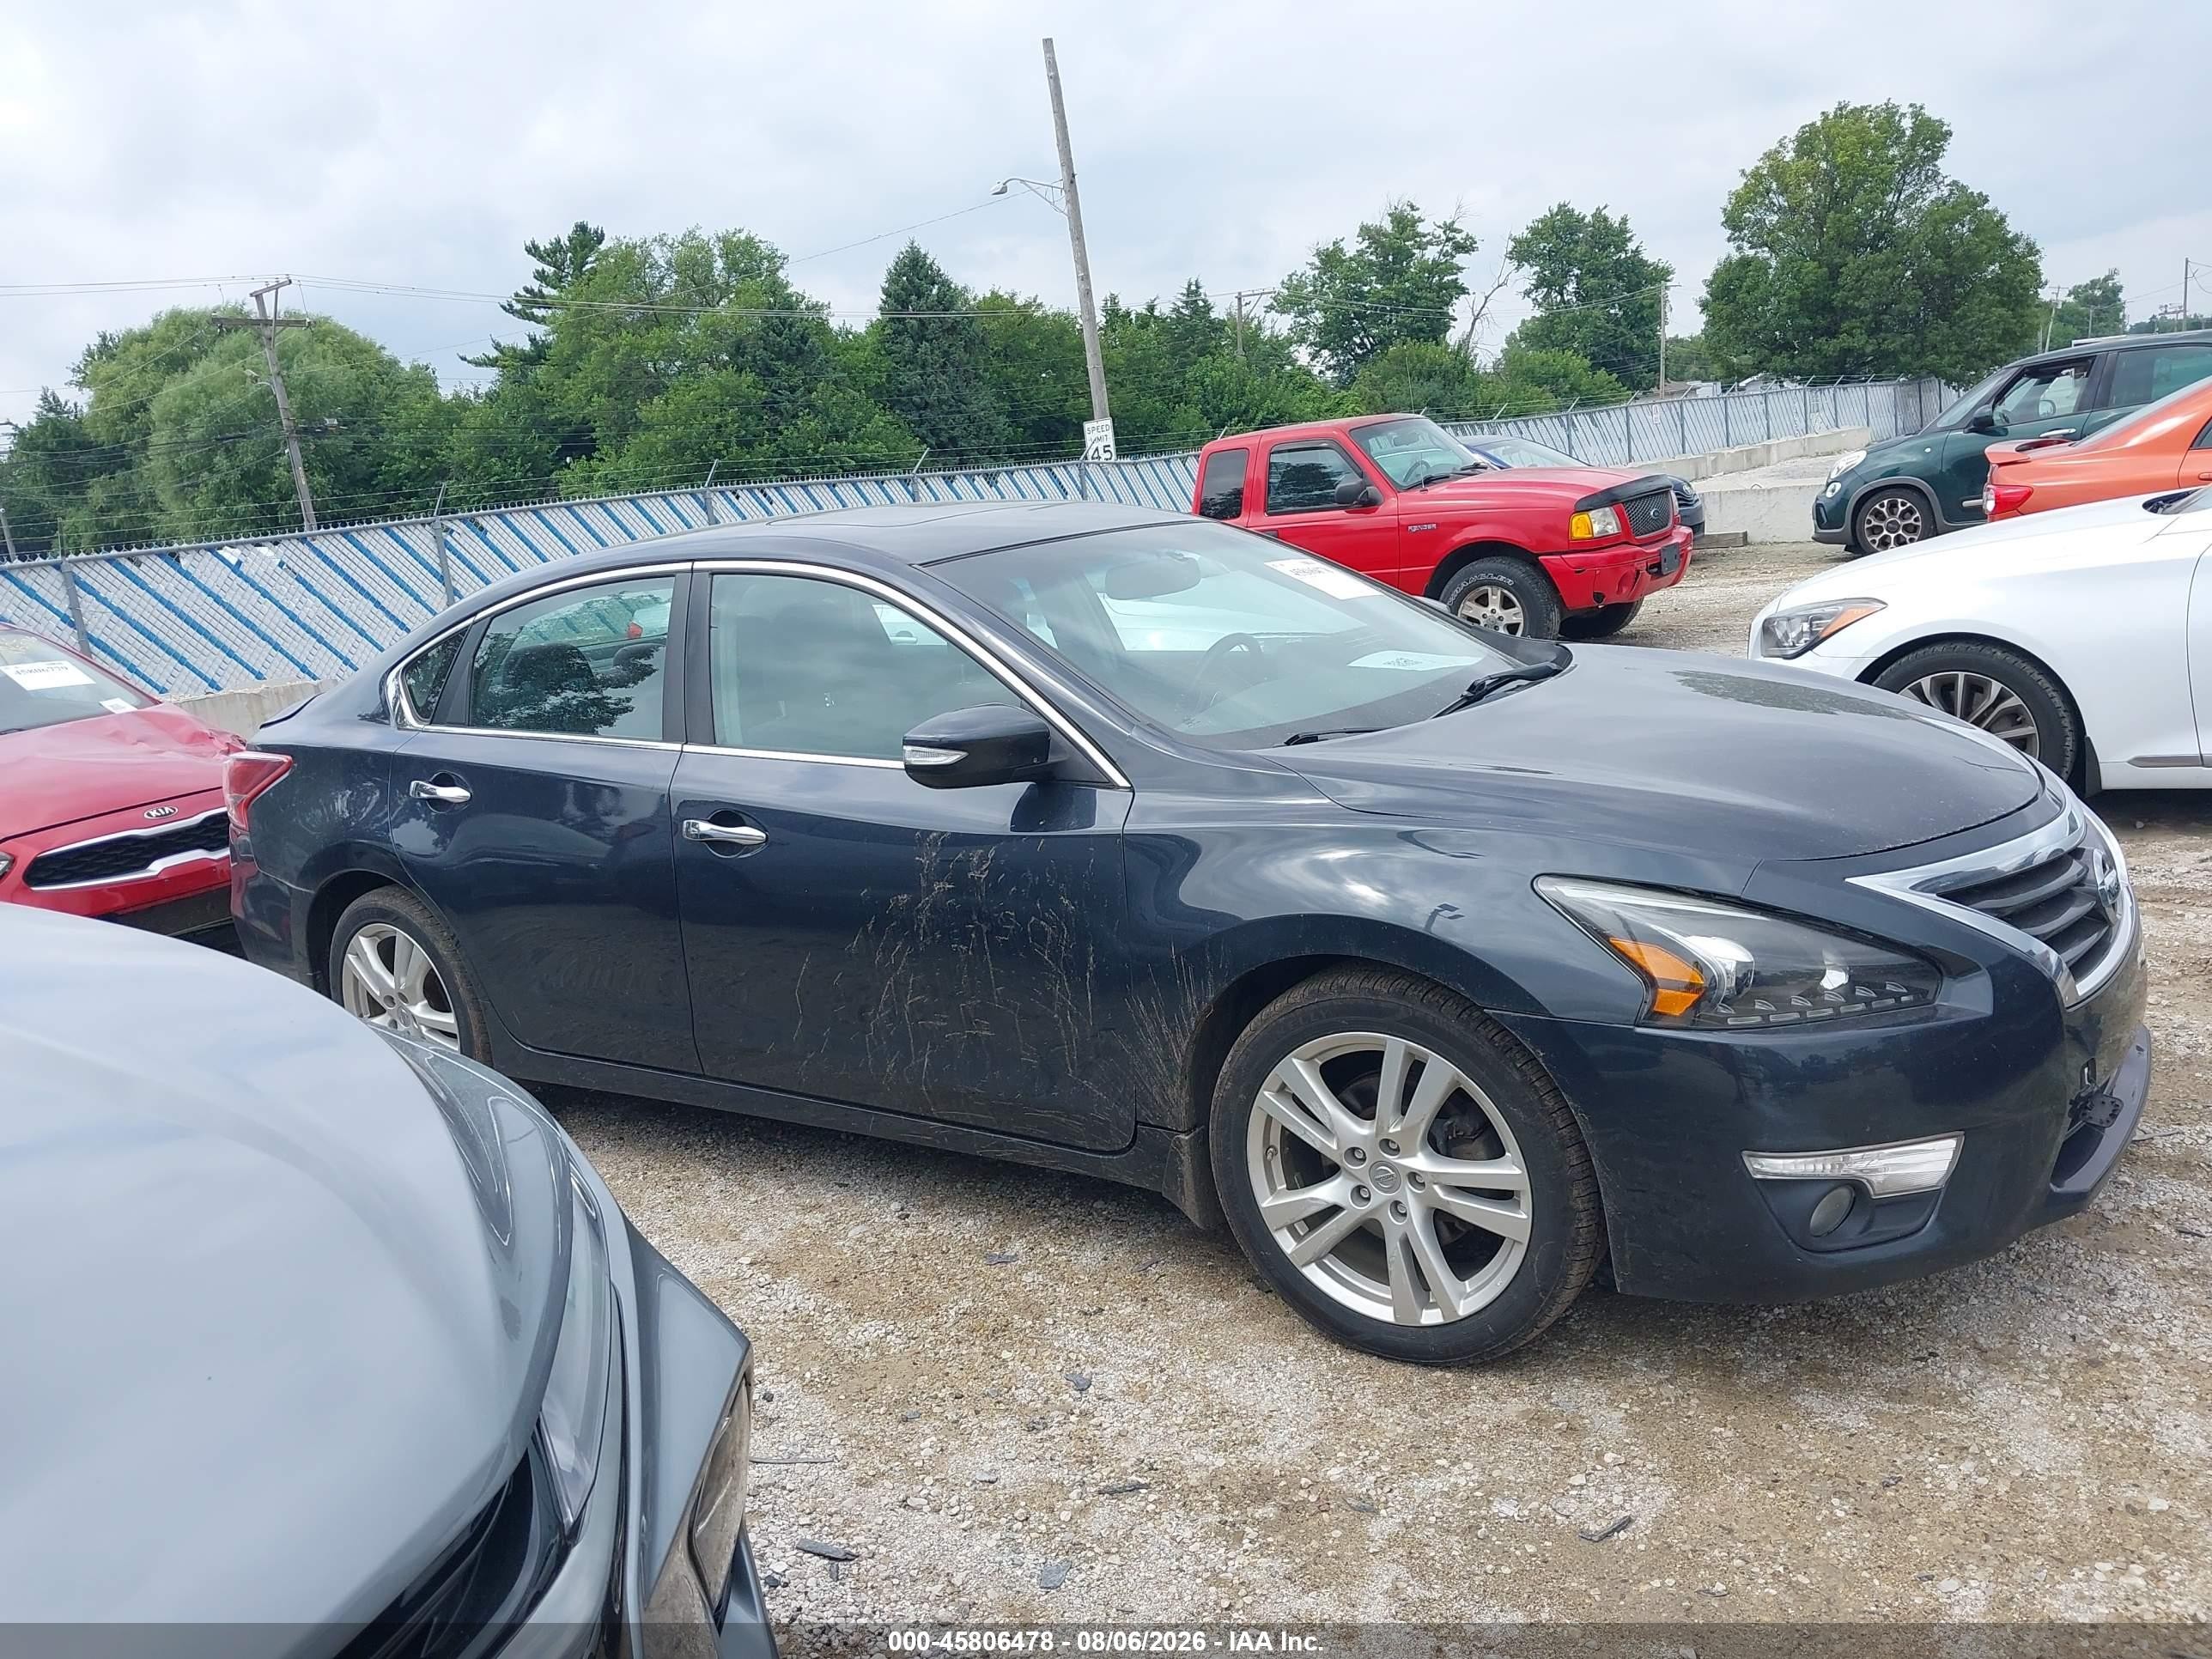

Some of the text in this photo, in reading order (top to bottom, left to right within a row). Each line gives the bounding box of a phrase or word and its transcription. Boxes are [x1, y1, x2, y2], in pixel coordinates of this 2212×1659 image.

[1086, 424, 1110, 434] SPEED
[1091, 444, 1113, 461] 45
[1447, 573, 1515, 606] WRANGLER
[147, 806, 175, 817] KIA
